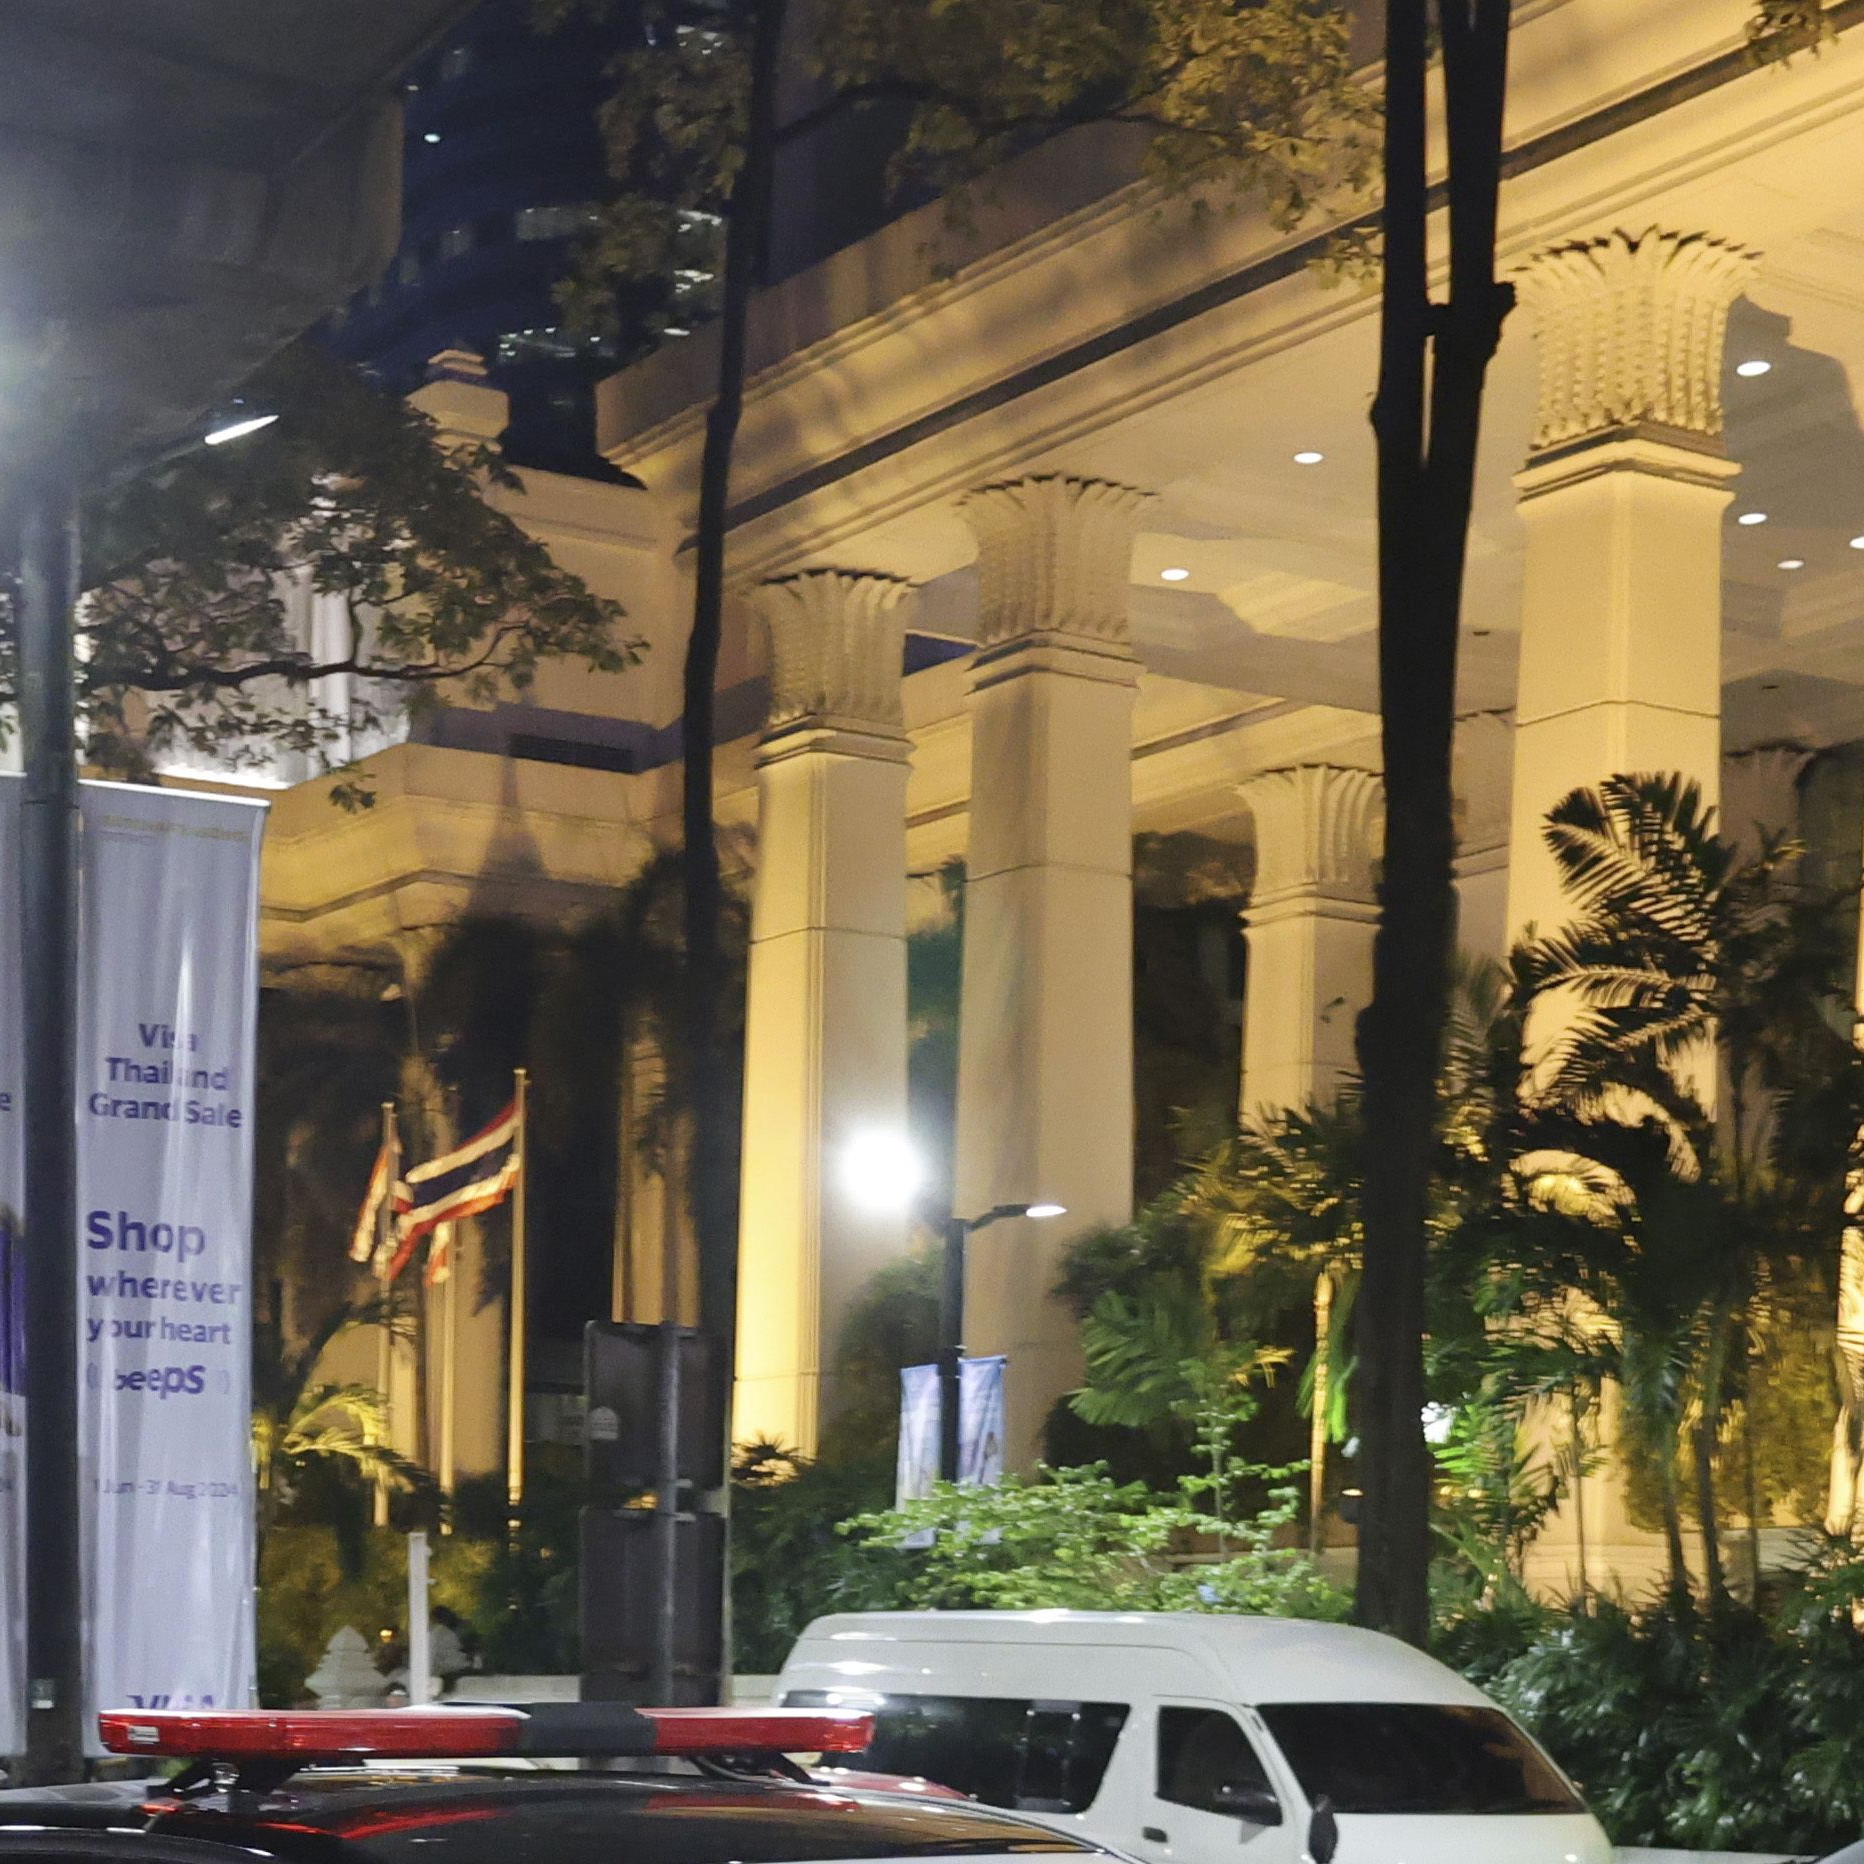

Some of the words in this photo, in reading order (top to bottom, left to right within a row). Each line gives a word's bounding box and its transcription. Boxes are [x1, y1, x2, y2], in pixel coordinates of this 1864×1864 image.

[139, 1022, 200, 1052] Via
[104, 1056, 230, 1091] Thailnd
[185, 1099, 242, 1128] Sale
[87, 1210, 206, 1264] Shop
[87, 1269, 242, 1305] wherever
[159, 1315, 232, 1346] heart
